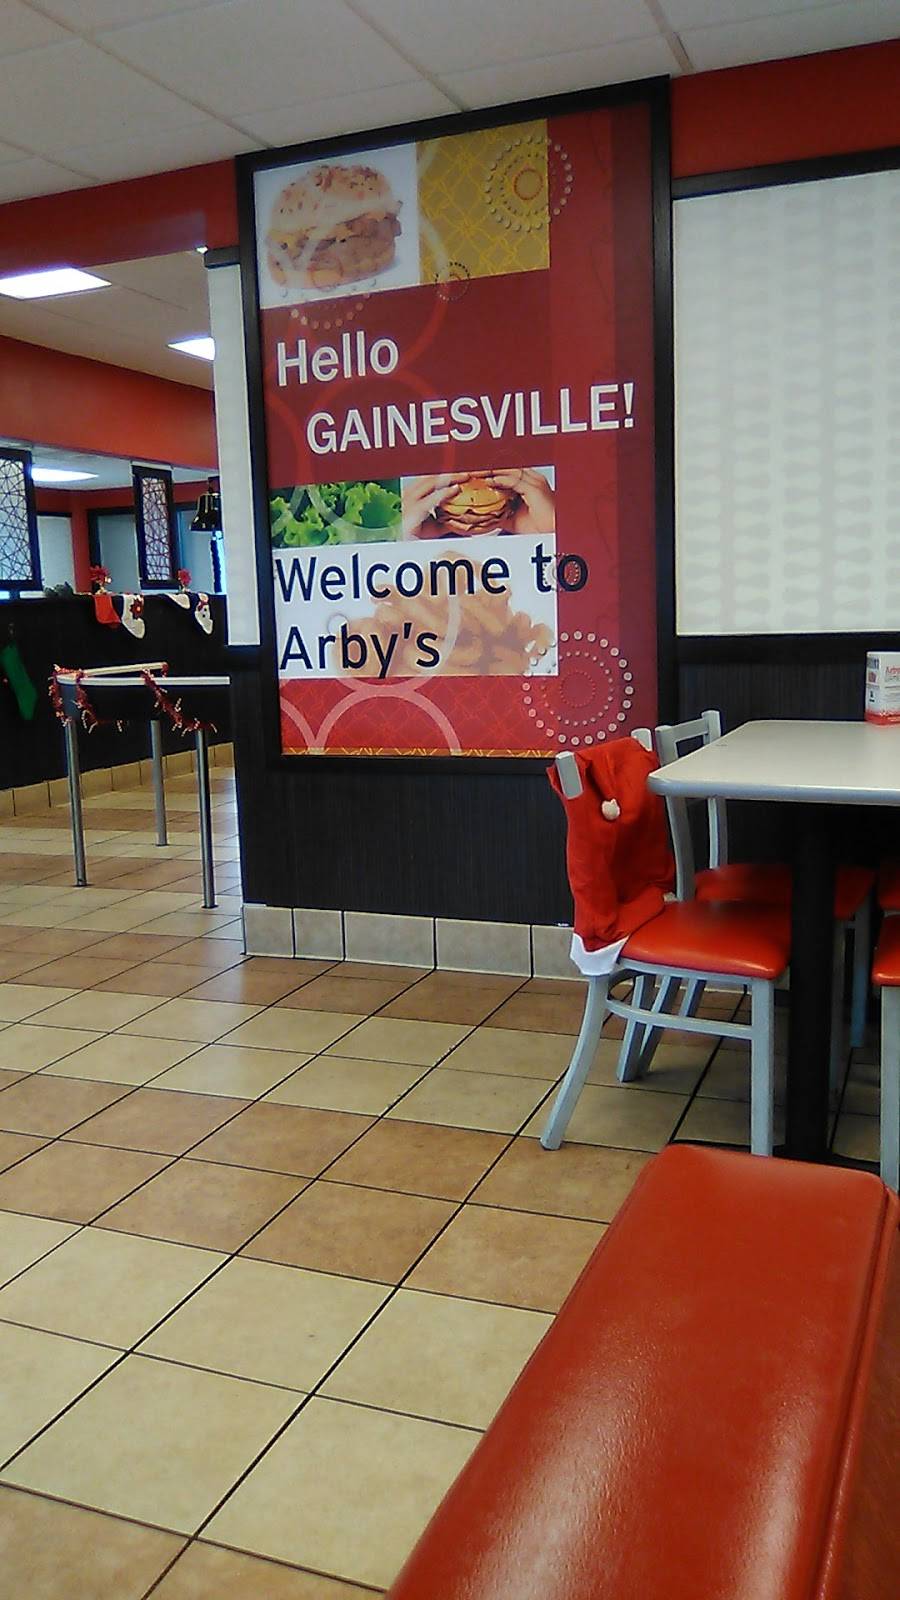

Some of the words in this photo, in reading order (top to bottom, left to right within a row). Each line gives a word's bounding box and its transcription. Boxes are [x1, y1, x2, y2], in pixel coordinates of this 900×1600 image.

[277, 331, 399, 386] Hello
[306, 382, 634, 455] GAINESVILLE!
[275, 551, 510, 602] Welcome
[531, 543, 589, 593] to
[279, 622, 442, 679] Arby's
